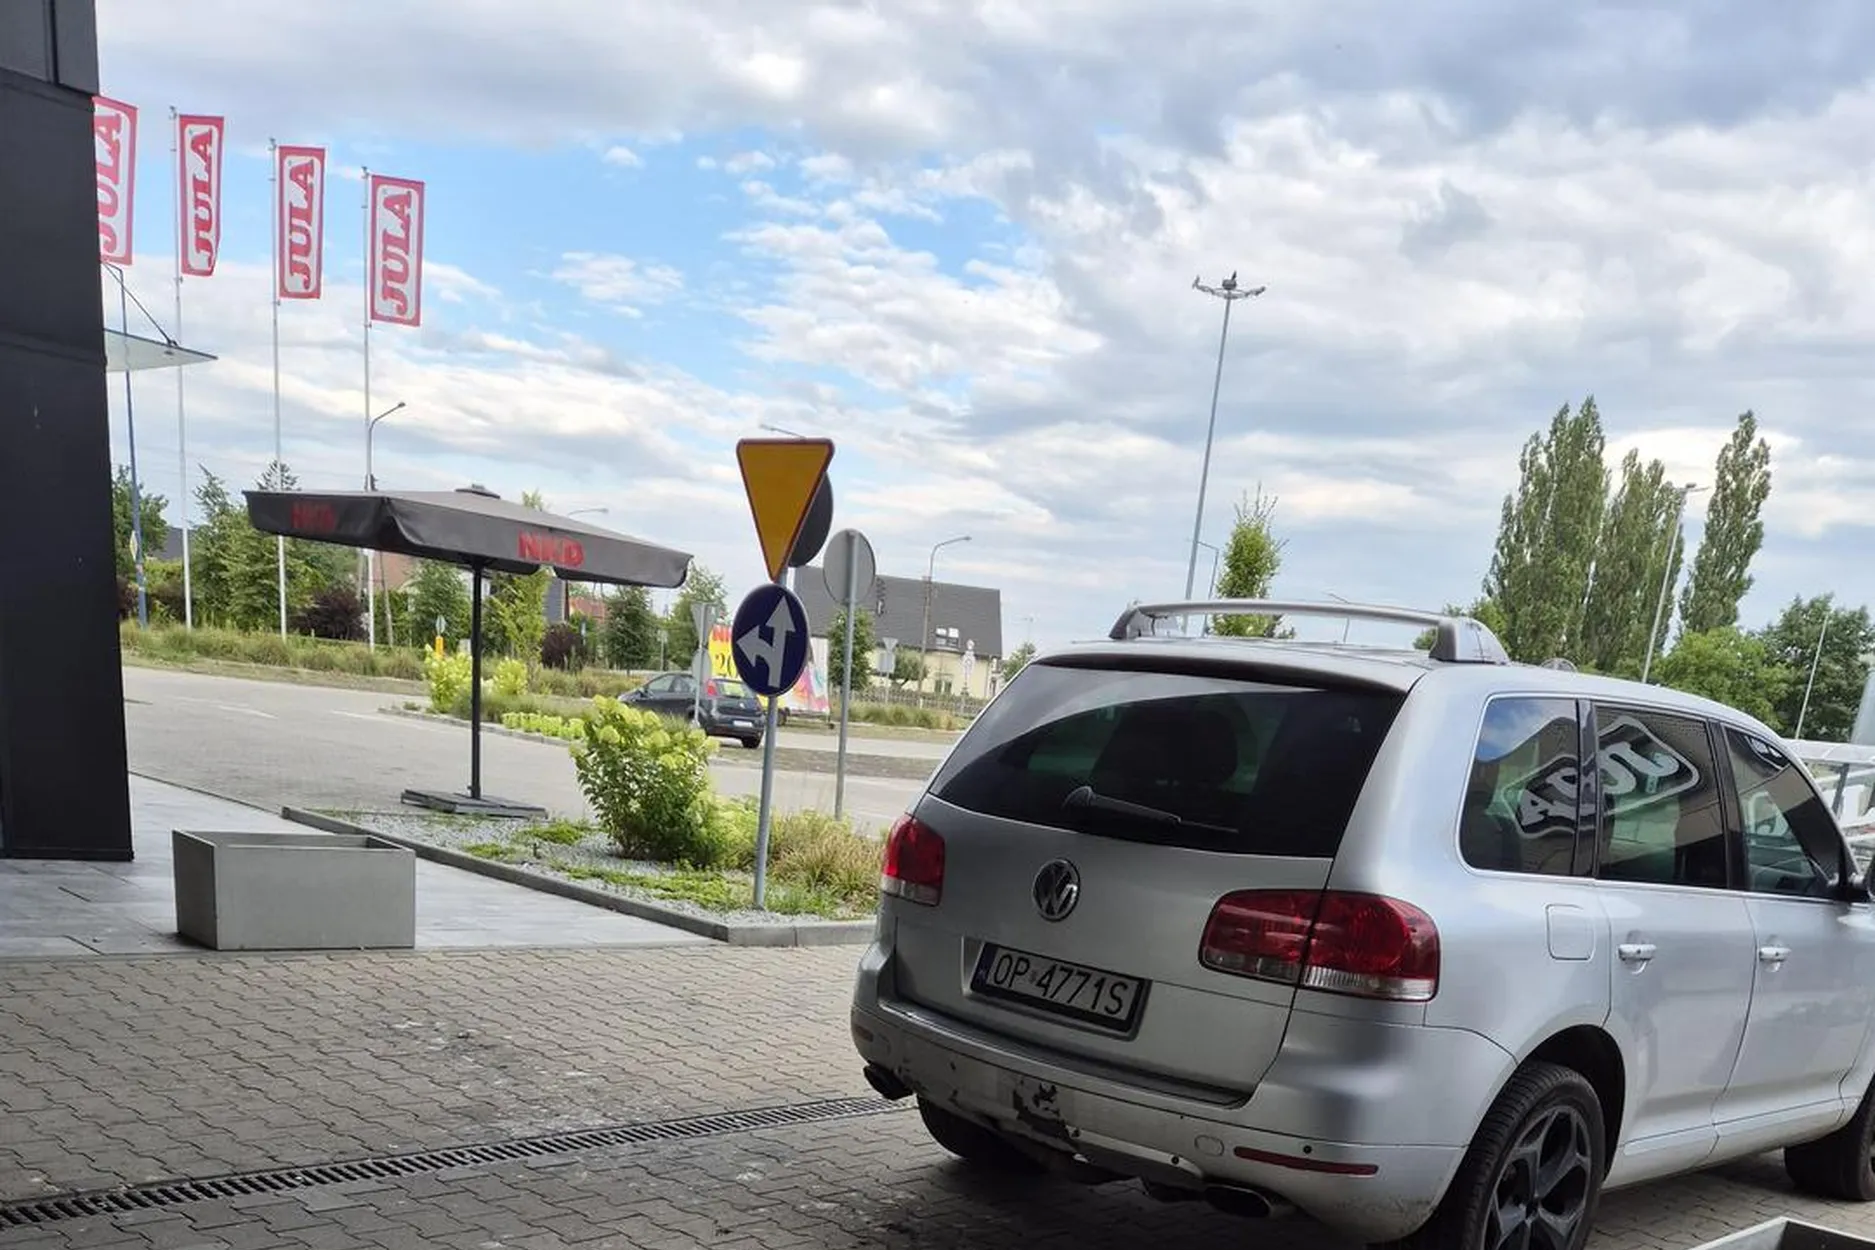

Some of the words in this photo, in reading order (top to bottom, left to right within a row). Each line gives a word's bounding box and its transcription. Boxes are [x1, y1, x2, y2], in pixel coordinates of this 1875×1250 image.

[190, 129, 213, 265] JULA
[288, 159, 315, 290] JULA
[380, 189, 413, 317] JULA
[517, 528, 585, 568] NKD
